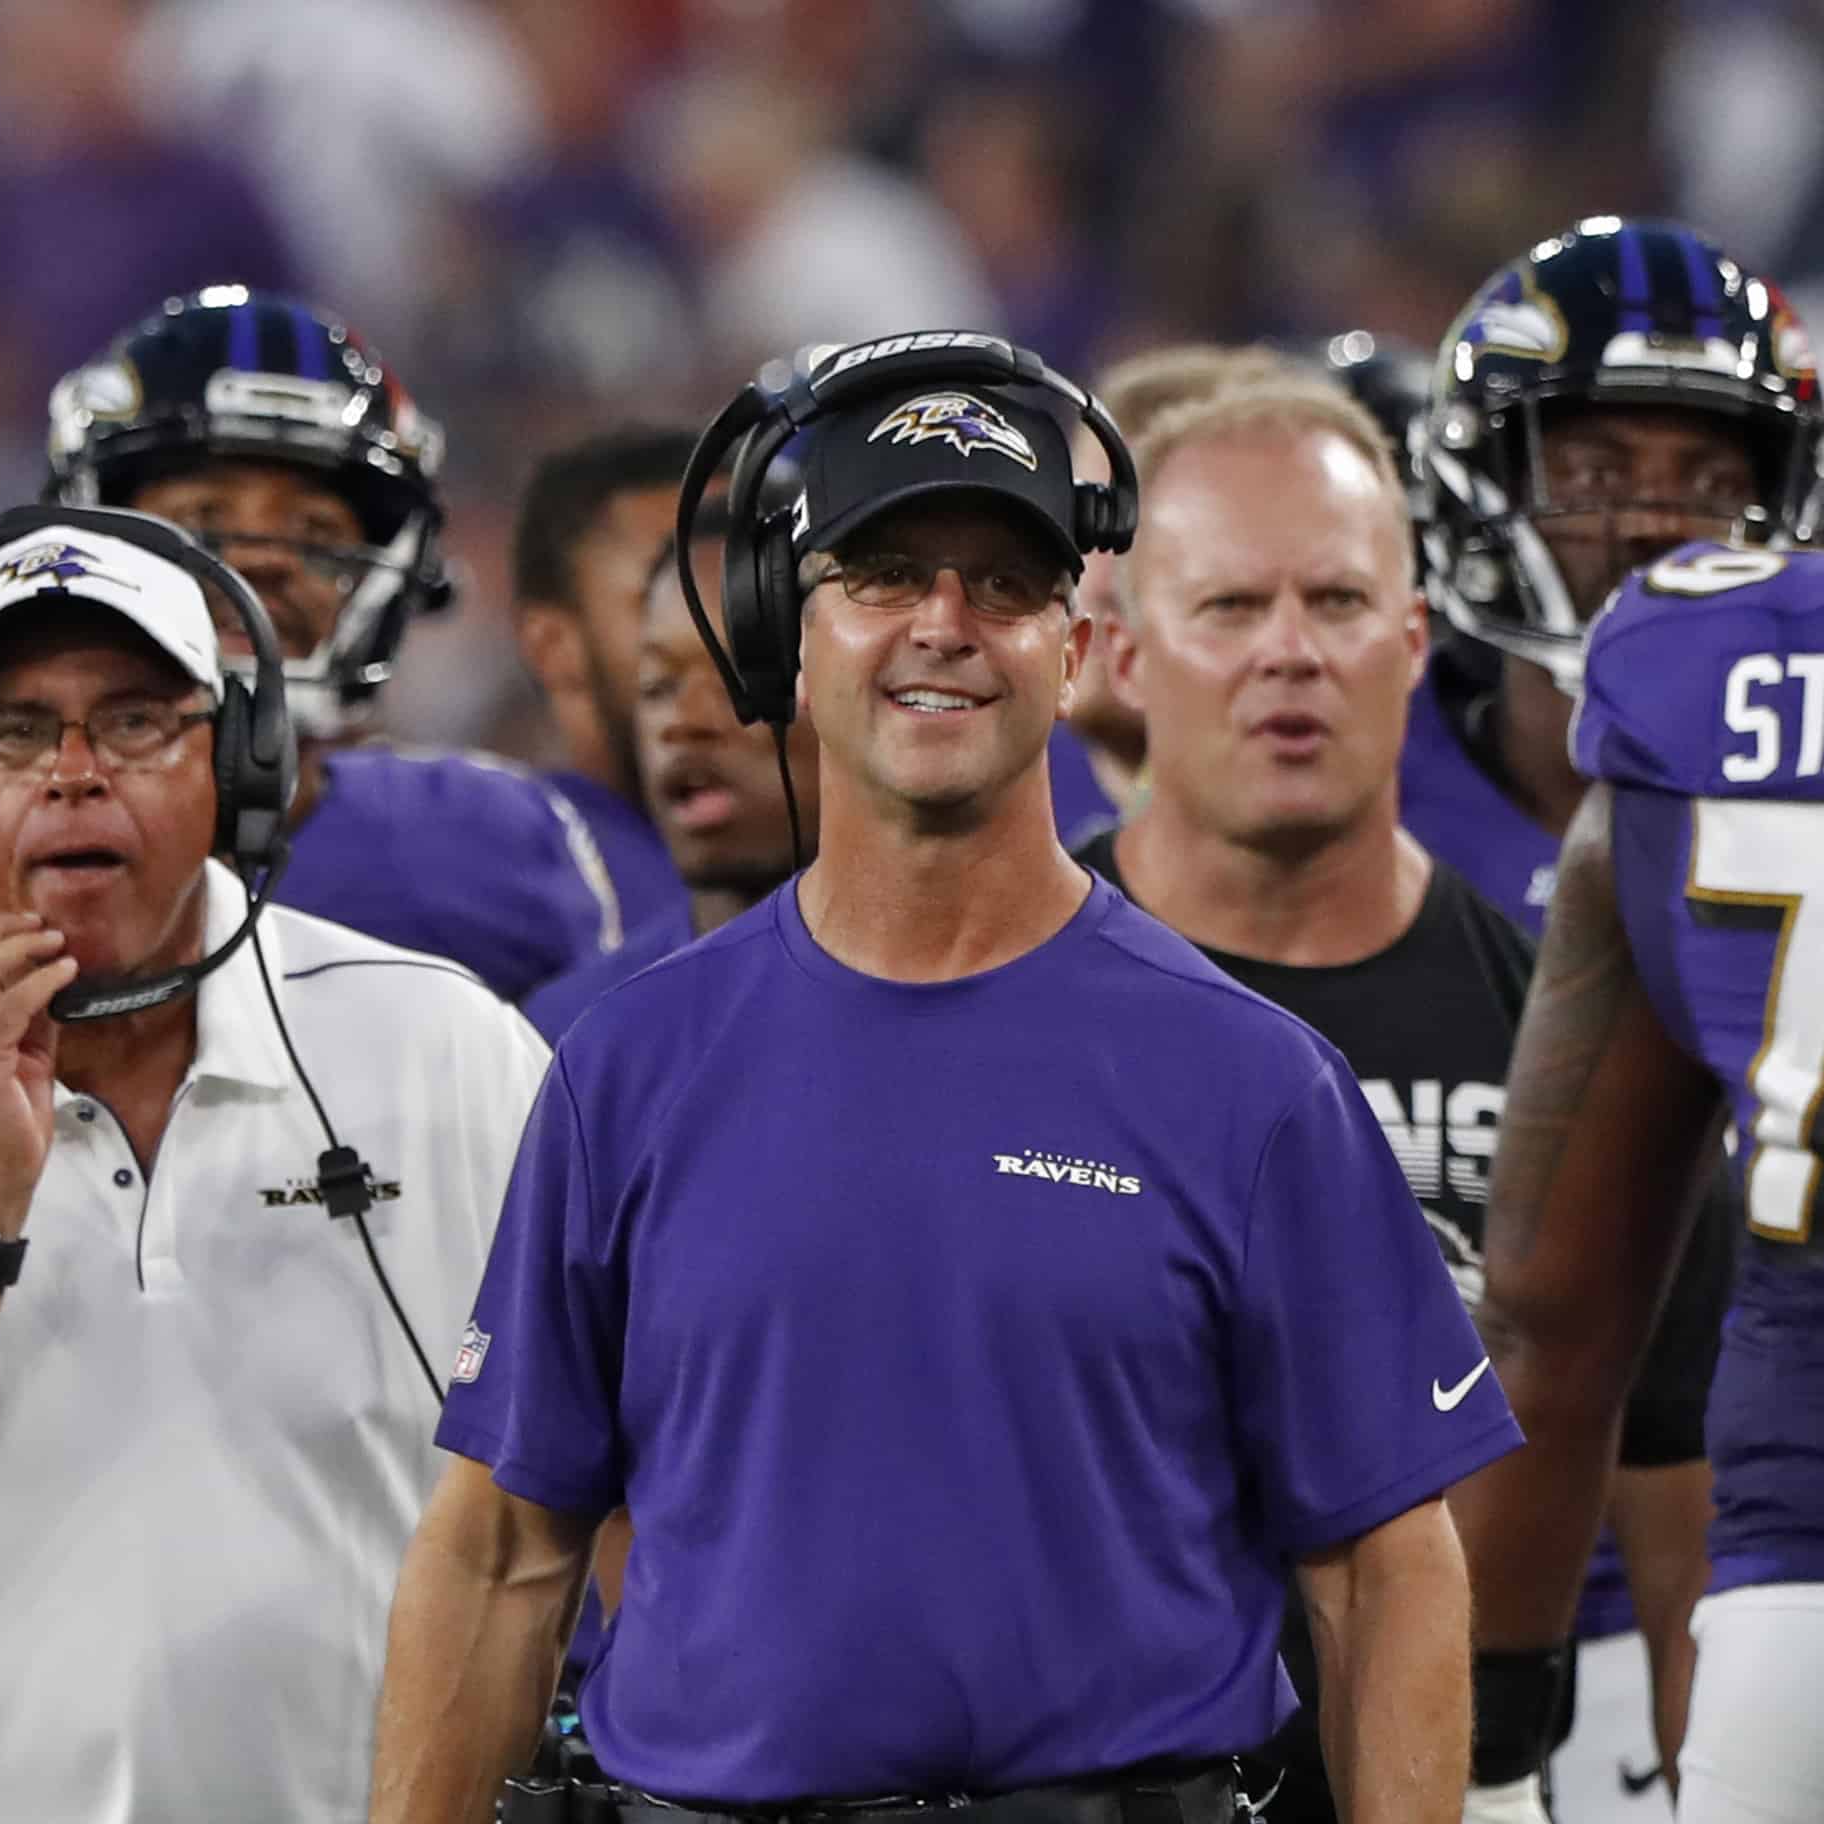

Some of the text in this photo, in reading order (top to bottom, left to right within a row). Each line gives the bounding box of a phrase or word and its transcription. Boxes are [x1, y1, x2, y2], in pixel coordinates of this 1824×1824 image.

[833, 333, 992, 373] BOSE
[256, 1179, 402, 1207] RAVS
[992, 1154, 1141, 1195] RAVENS
